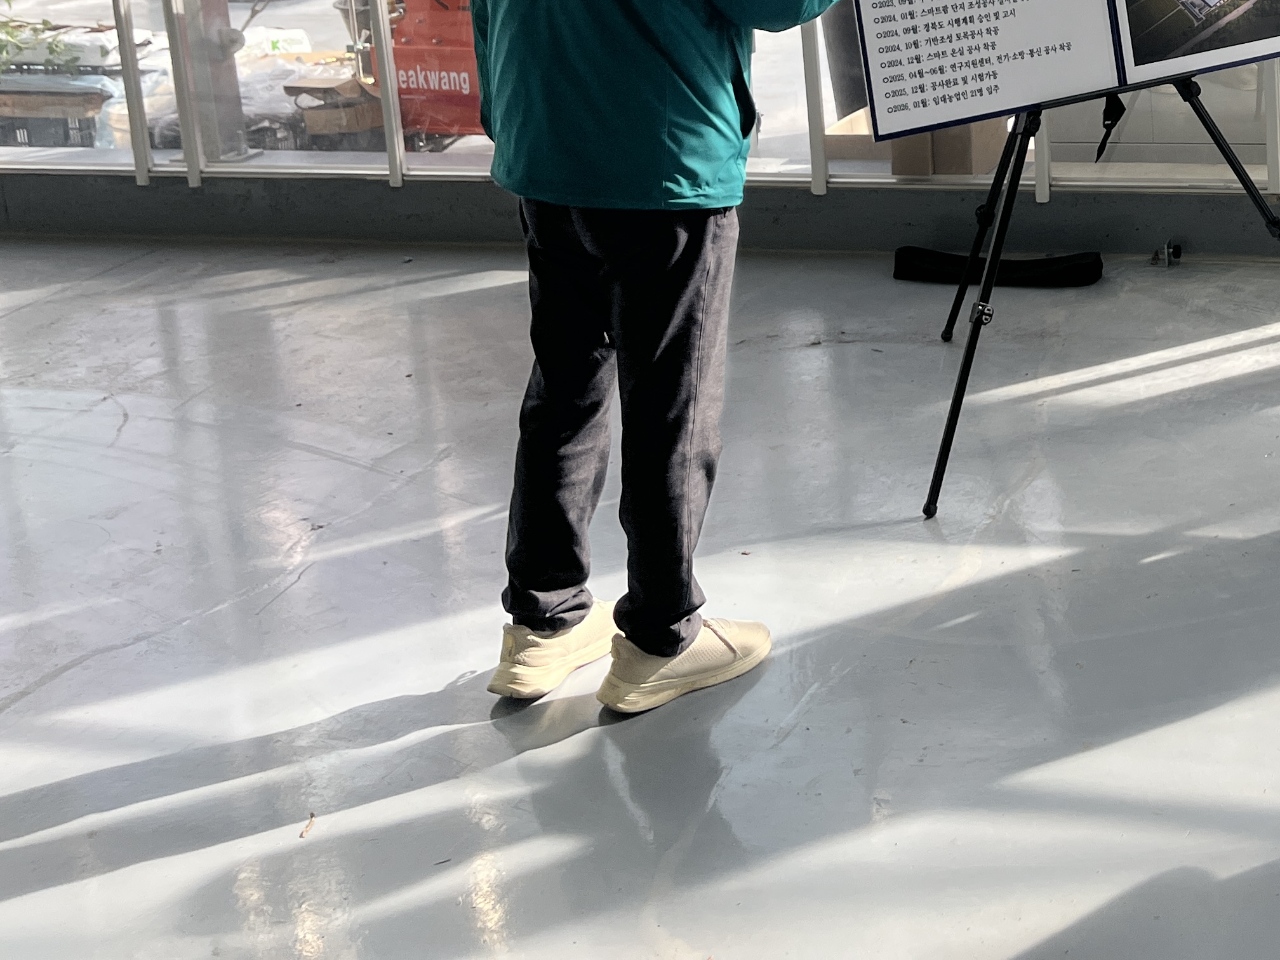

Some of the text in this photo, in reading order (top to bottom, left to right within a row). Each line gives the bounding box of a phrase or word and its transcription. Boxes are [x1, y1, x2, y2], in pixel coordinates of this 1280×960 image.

[920, 4, 948, 17] 스마트팜
[950, 1, 965, 12] 단지
[923, 20, 944, 32] 경북도
[947, 14, 974, 27] 시행계획
[977, 12, 991, 23] 승인
[992, 10, 1000, 20] 및
[1002, 7, 1015, 18] 고시
[924, 33, 952, 46] 기반조성
[955, 28, 983, 41] 토목공사
[985, 25, 999, 36] 착공
[926, 50, 948, 60] 스마트
[950, 46, 964, 57] 온실
[966, 43, 980, 54] 공사
[982, 41, 996, 51] 착공
[1043, 43, 1057, 54] 공사
[1058, 41, 1071, 51] 착공
[398, 65, 470, 94] eakwang
[930, 77, 959, 91] 공사완료
[960, 75, 968, 85] 및
[932, 89, 968, 105] 임대농업인
[985, 84, 999, 95] 입주
